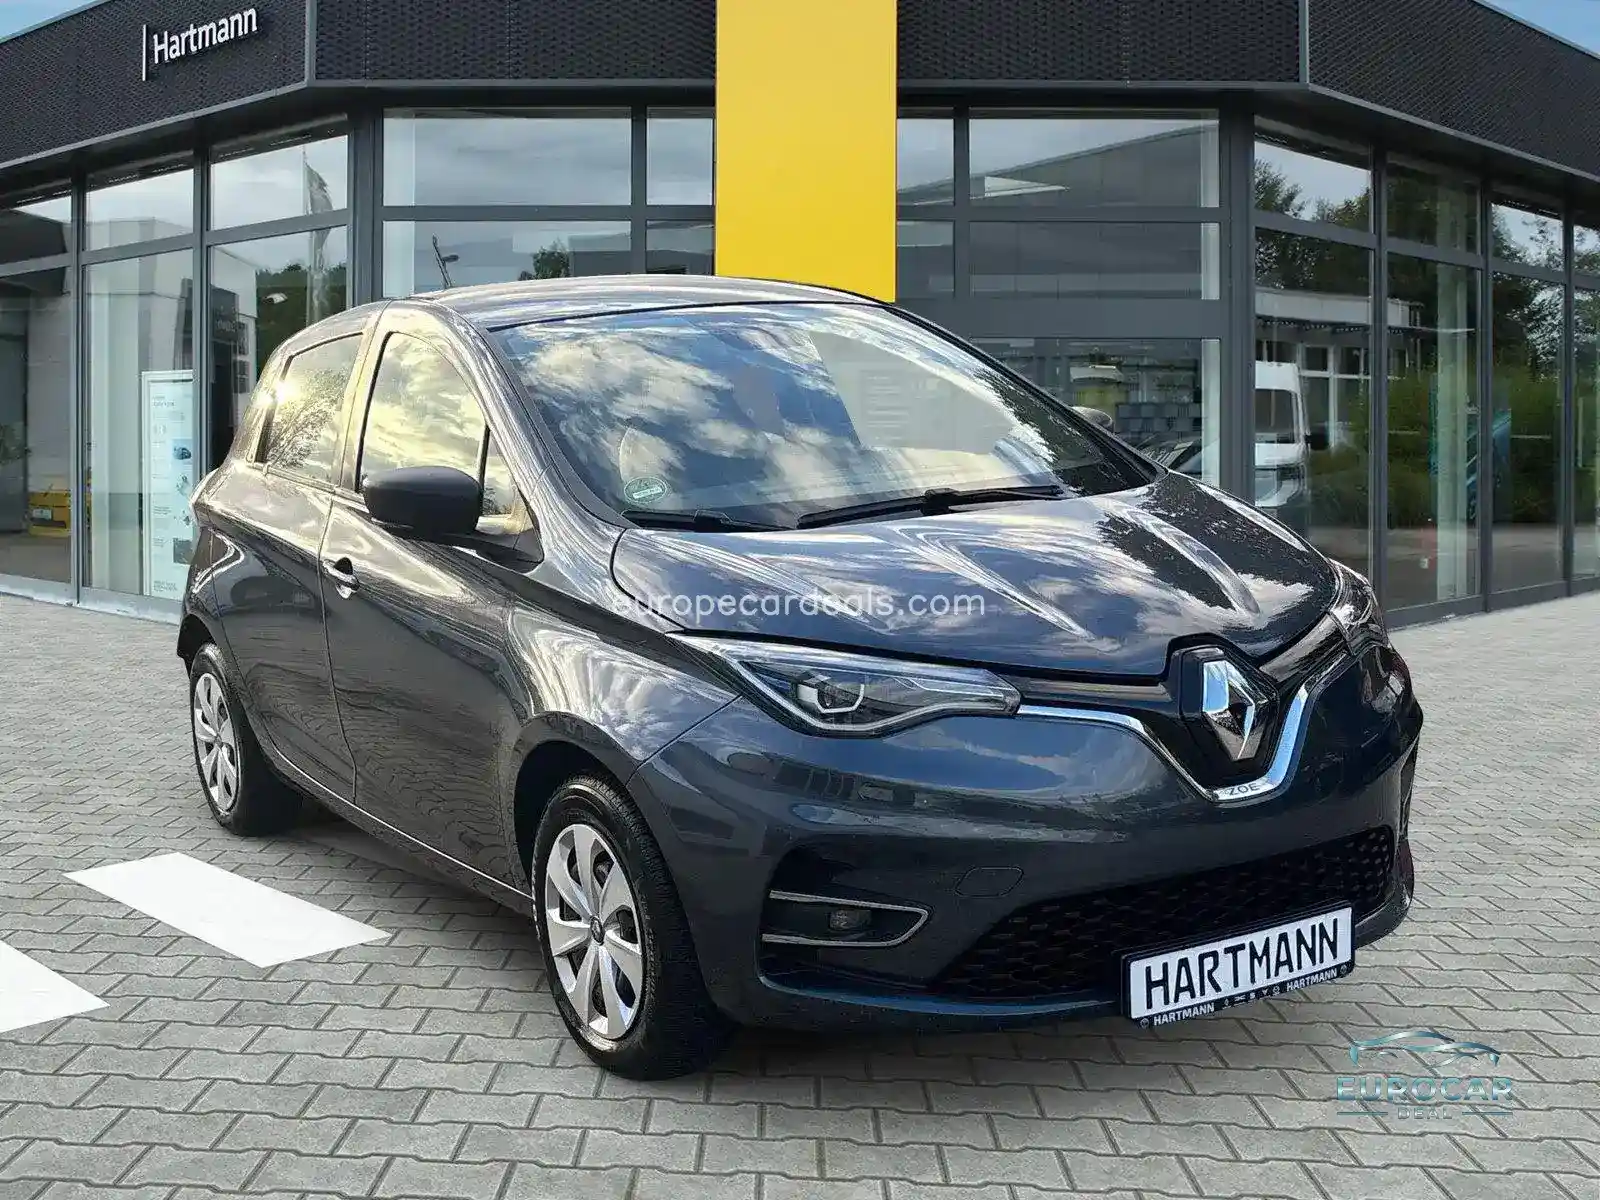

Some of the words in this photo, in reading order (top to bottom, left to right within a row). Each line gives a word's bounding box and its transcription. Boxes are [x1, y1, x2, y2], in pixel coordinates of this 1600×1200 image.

[153, 7, 258, 64] Hartmann
[1229, 782, 1260, 796] ZOE
[1145, 917, 1338, 1010] HARTMANN
[1285, 968, 1338, 992] HARTMANN
[1153, 1002, 1215, 1026] HARTMANN
